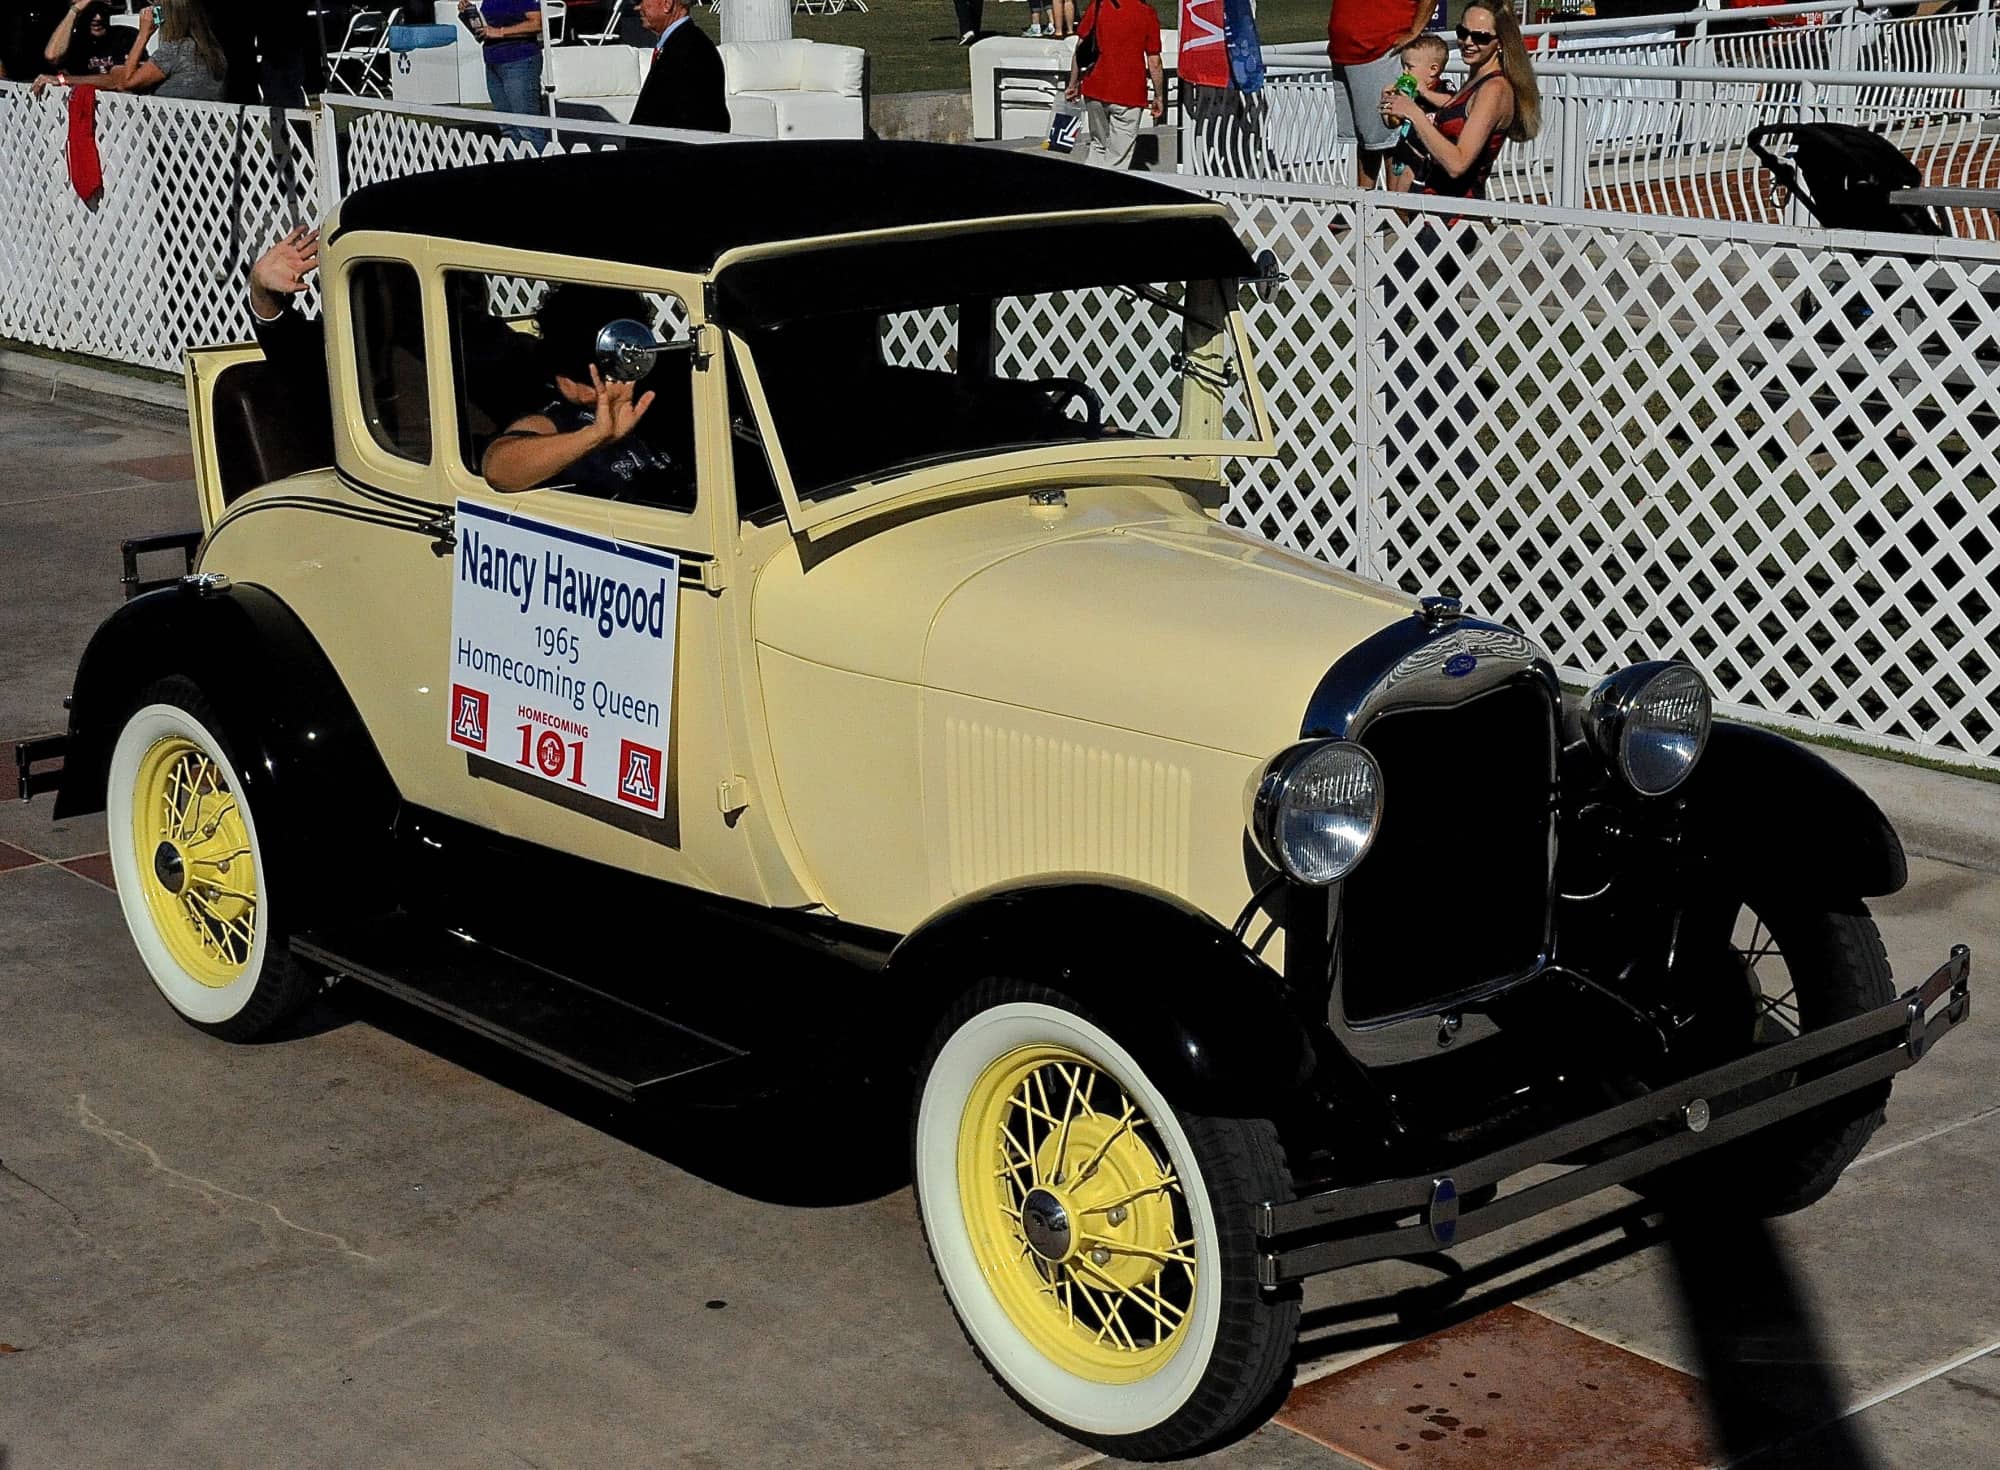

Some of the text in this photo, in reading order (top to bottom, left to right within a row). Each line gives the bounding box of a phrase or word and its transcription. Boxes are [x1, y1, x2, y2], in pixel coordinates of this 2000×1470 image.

[462, 527, 666, 639] Nancy Hawgood
[535, 625, 580, 664] 1965
[457, 637, 659, 727] Homecoming Queen
[455, 694, 483, 743] A
[518, 704, 589, 738] HOMECOMING
[515, 723, 587, 787] 101
[622, 750, 655, 802] A
